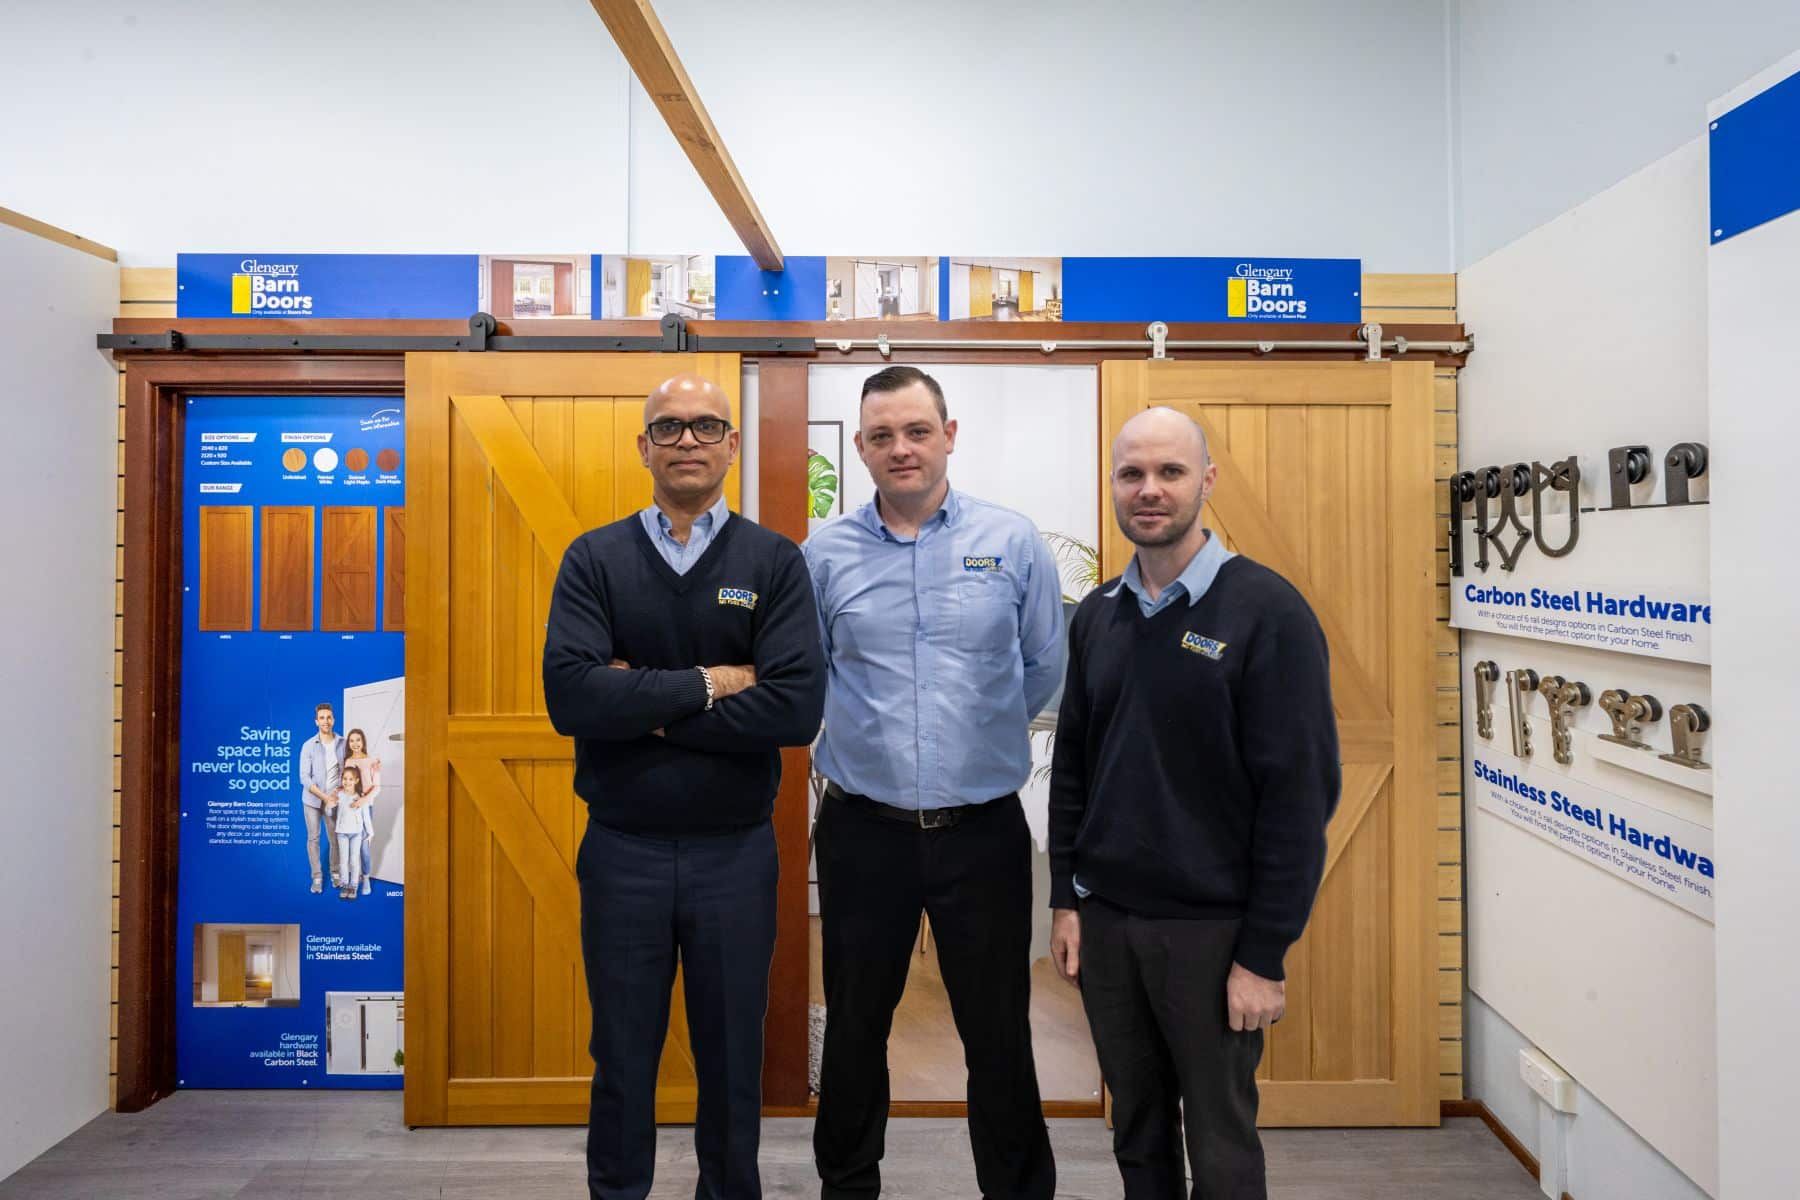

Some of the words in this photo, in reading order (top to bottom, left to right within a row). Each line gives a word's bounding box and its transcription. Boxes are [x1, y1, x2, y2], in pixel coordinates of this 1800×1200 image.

[240, 260, 298, 278] Glengary
[1236, 264, 1292, 281] Glengary
[252, 276, 299, 292] Barn
[1248, 280, 1293, 296] Barn
[252, 293, 312, 308] Doors
[1248, 296, 1306, 313] Doors
[966, 558, 996, 567] DOORS
[721, 590, 752, 602] DOORS
[1465, 584, 1526, 607] Carbon
[1530, 588, 1581, 612] Steel
[1478, 609, 1491, 618] With
[1496, 612, 1516, 620] choice
[1530, 615, 1540, 624] rail
[1541, 616, 1567, 630] designs
[1568, 620, 1596, 632] options
[1598, 623, 1606, 631] in
[1607, 624, 1639, 636] Carbon
[1641, 627, 1664, 638] Steel
[1666, 630, 1693, 642] finish.
[1497, 620, 1507, 629] You
[1520, 624, 1532, 632] find
[1533, 626, 1544, 634] the
[1545, 627, 1569, 638] perfect
[1570, 630, 1596, 644] option
[1597, 634, 1609, 642] for
[1610, 637, 1630, 646] your
[1187, 633, 1219, 651] DOORS
[241, 726, 290, 744] Saving
[217, 745, 261, 760] space
[264, 743, 290, 757] has
[192, 762, 236, 773] never
[238, 760, 290, 773] looked
[228, 779, 246, 790] so
[249, 776, 290, 793] good
[1474, 759, 1547, 806] Stainless
[1550, 790, 1603, 831] Steel
[1490, 790, 1504, 801] With
[1509, 800, 1528, 814] choice
[1543, 815, 1552, 824] rail
[1554, 820, 1580, 838] designs
[1581, 832, 1610, 852] options
[1612, 846, 1620, 855] in
[1620, 848, 1657, 872] Stainless
[1658, 865, 1681, 884] Steel
[1683, 877, 1713, 898] finish.
[1511, 808, 1522, 819] You
[1523, 815, 1534, 824] will
[1534, 819, 1546, 830] find
[1547, 826, 1559, 836] the
[1559, 832, 1585, 848] perfect
[1586, 843, 1611, 861] option
[1613, 856, 1624, 866] for
[1626, 864, 1646, 877] your
[306, 935, 343, 944] Glengary
[316, 952, 350, 960] Stainless
[280, 1033, 318, 1042] Glengary
